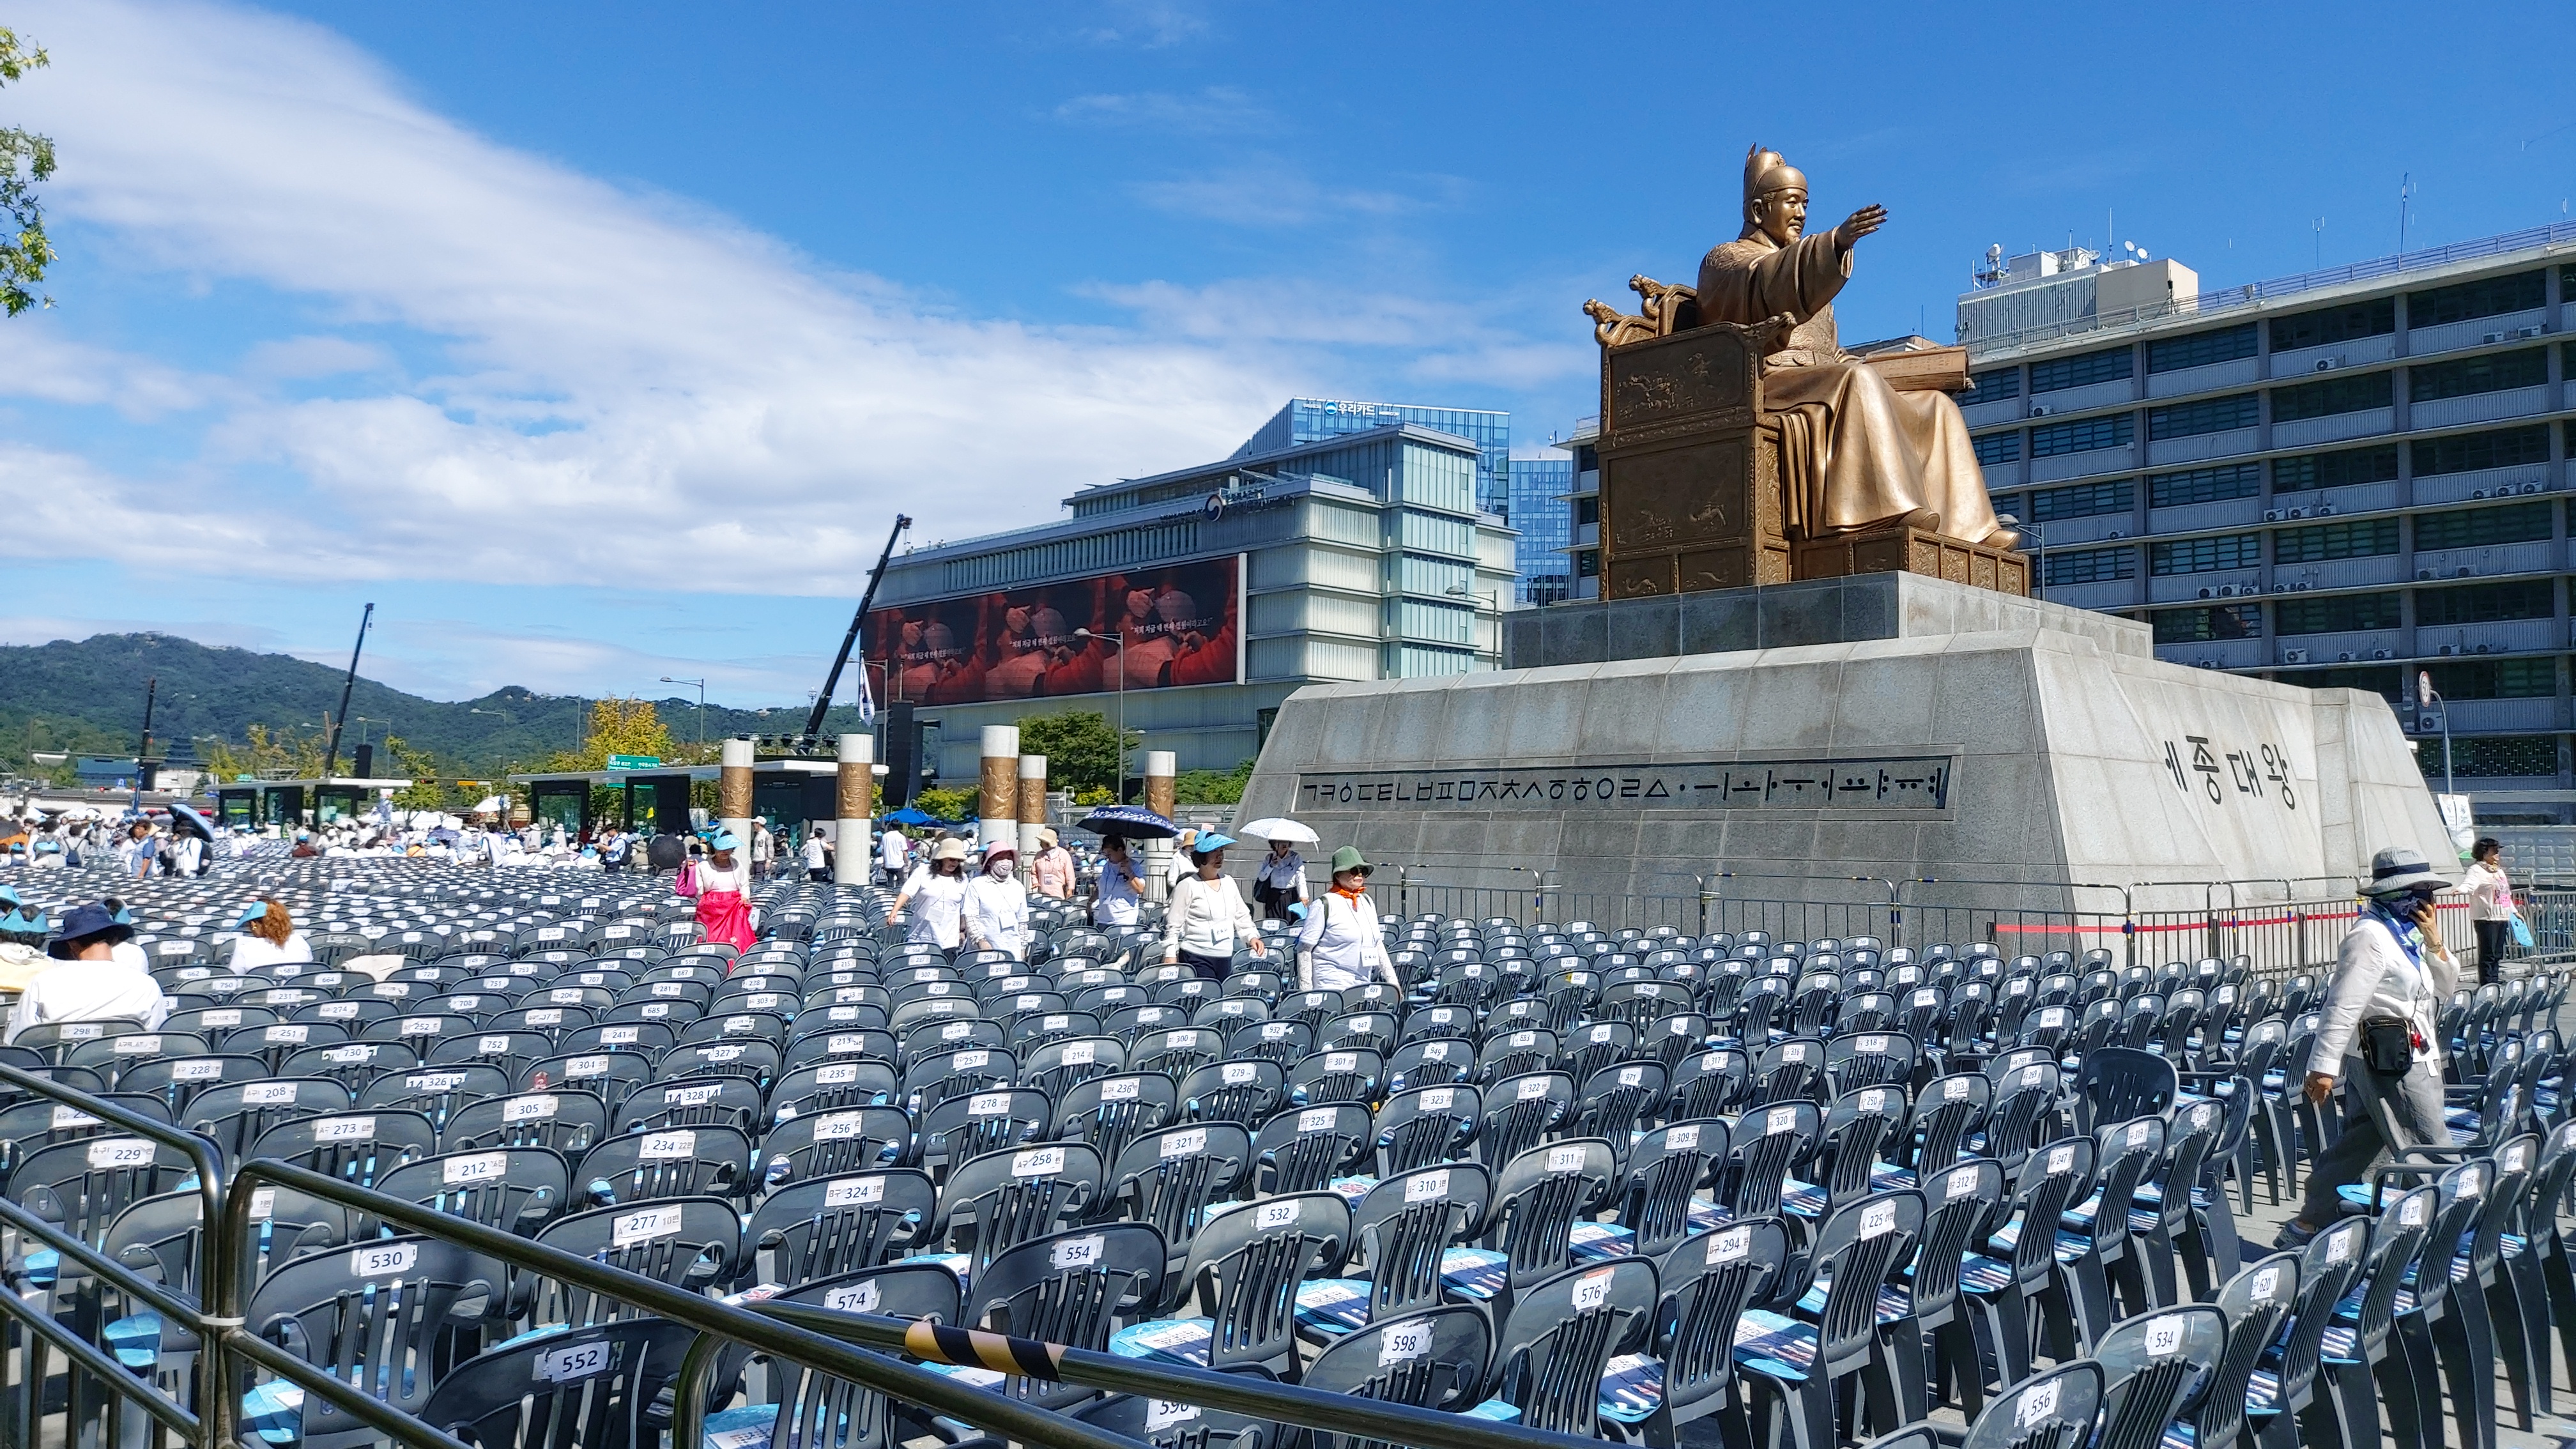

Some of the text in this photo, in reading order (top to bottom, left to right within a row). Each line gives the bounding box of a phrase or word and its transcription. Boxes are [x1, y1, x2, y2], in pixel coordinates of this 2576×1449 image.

[1338, 402, 1376, 416] 우리카드
[414, 1022, 430, 1031] 252
[1358, 1021, 1368, 1029] 947
[1176, 1034, 1188, 1043] 300
[1597, 1031, 1607, 1039] 927
[836, 1037, 852, 1045] 213
[1865, 1038, 1878, 1046] 318
[344, 1048, 362, 1057] 730
[715, 1049, 730, 1057] 327
[1071, 1051, 1085, 1059] 214
[1430, 1048, 1441, 1056] 949
[965, 1055, 978, 1064] 257
[1334, 1057, 1347, 1066] 301
[1711, 1056, 1721, 1064] 317
[190, 1066, 210, 1075] 228
[829, 1070, 846, 1078] 235
[1232, 1068, 1245, 1077] 279
[429, 1077, 447, 1086] 326
[1625, 1072, 1636, 1082] 971
[1117, 1084, 1132, 1094] 236
[1528, 1084, 1540, 1092] 322
[1954, 1082, 1965, 1091] 313
[266, 1087, 286, 1098] 208
[685, 1091, 704, 1100] 328
[980, 1098, 997, 1108] 278
[1430, 1095, 1445, 1105] 323
[1867, 1096, 1878, 1105] 250
[519, 1104, 539, 1114] 305
[1310, 1114, 1326, 1126] 325
[1775, 1115, 1788, 1126] 320
[334, 1124, 356, 1135] 273
[832, 1123, 850, 1133] 256
[1676, 1132, 1690, 1142] 309
[653, 1140, 675, 1151] 234
[1175, 1137, 1192, 1149] 321
[114, 1149, 141, 1161] 229
[1032, 1154, 1052, 1166] 258
[1560, 1153, 1574, 1165] 311
[2056, 1153, 2067, 1165] 247
[462, 1162, 487, 1176] 212
[1418, 1180, 1436, 1192] 310
[1956, 1177, 1970, 1188] 312
[845, 1188, 868, 1199] 324
[1268, 1208, 1289, 1222] 532
[631, 1215, 657, 1230] 277
[1868, 1216, 1883, 1229] 225
[1722, 1238, 1741, 1254] 294
[2335, 1239, 2346, 1254] 270
[1065, 1245, 1091, 1261] 554
[370, 1252, 403, 1269] 530
[2259, 1276, 2271, 1291] 620
[1581, 1285, 1602, 1303] 576
[838, 1292, 866, 1310] 574
[1391, 1335, 1417, 1352] 598
[2155, 1331, 2174, 1348] 534
[562, 1351, 599, 1373] 552
[2030, 1395, 2051, 1416] 556
